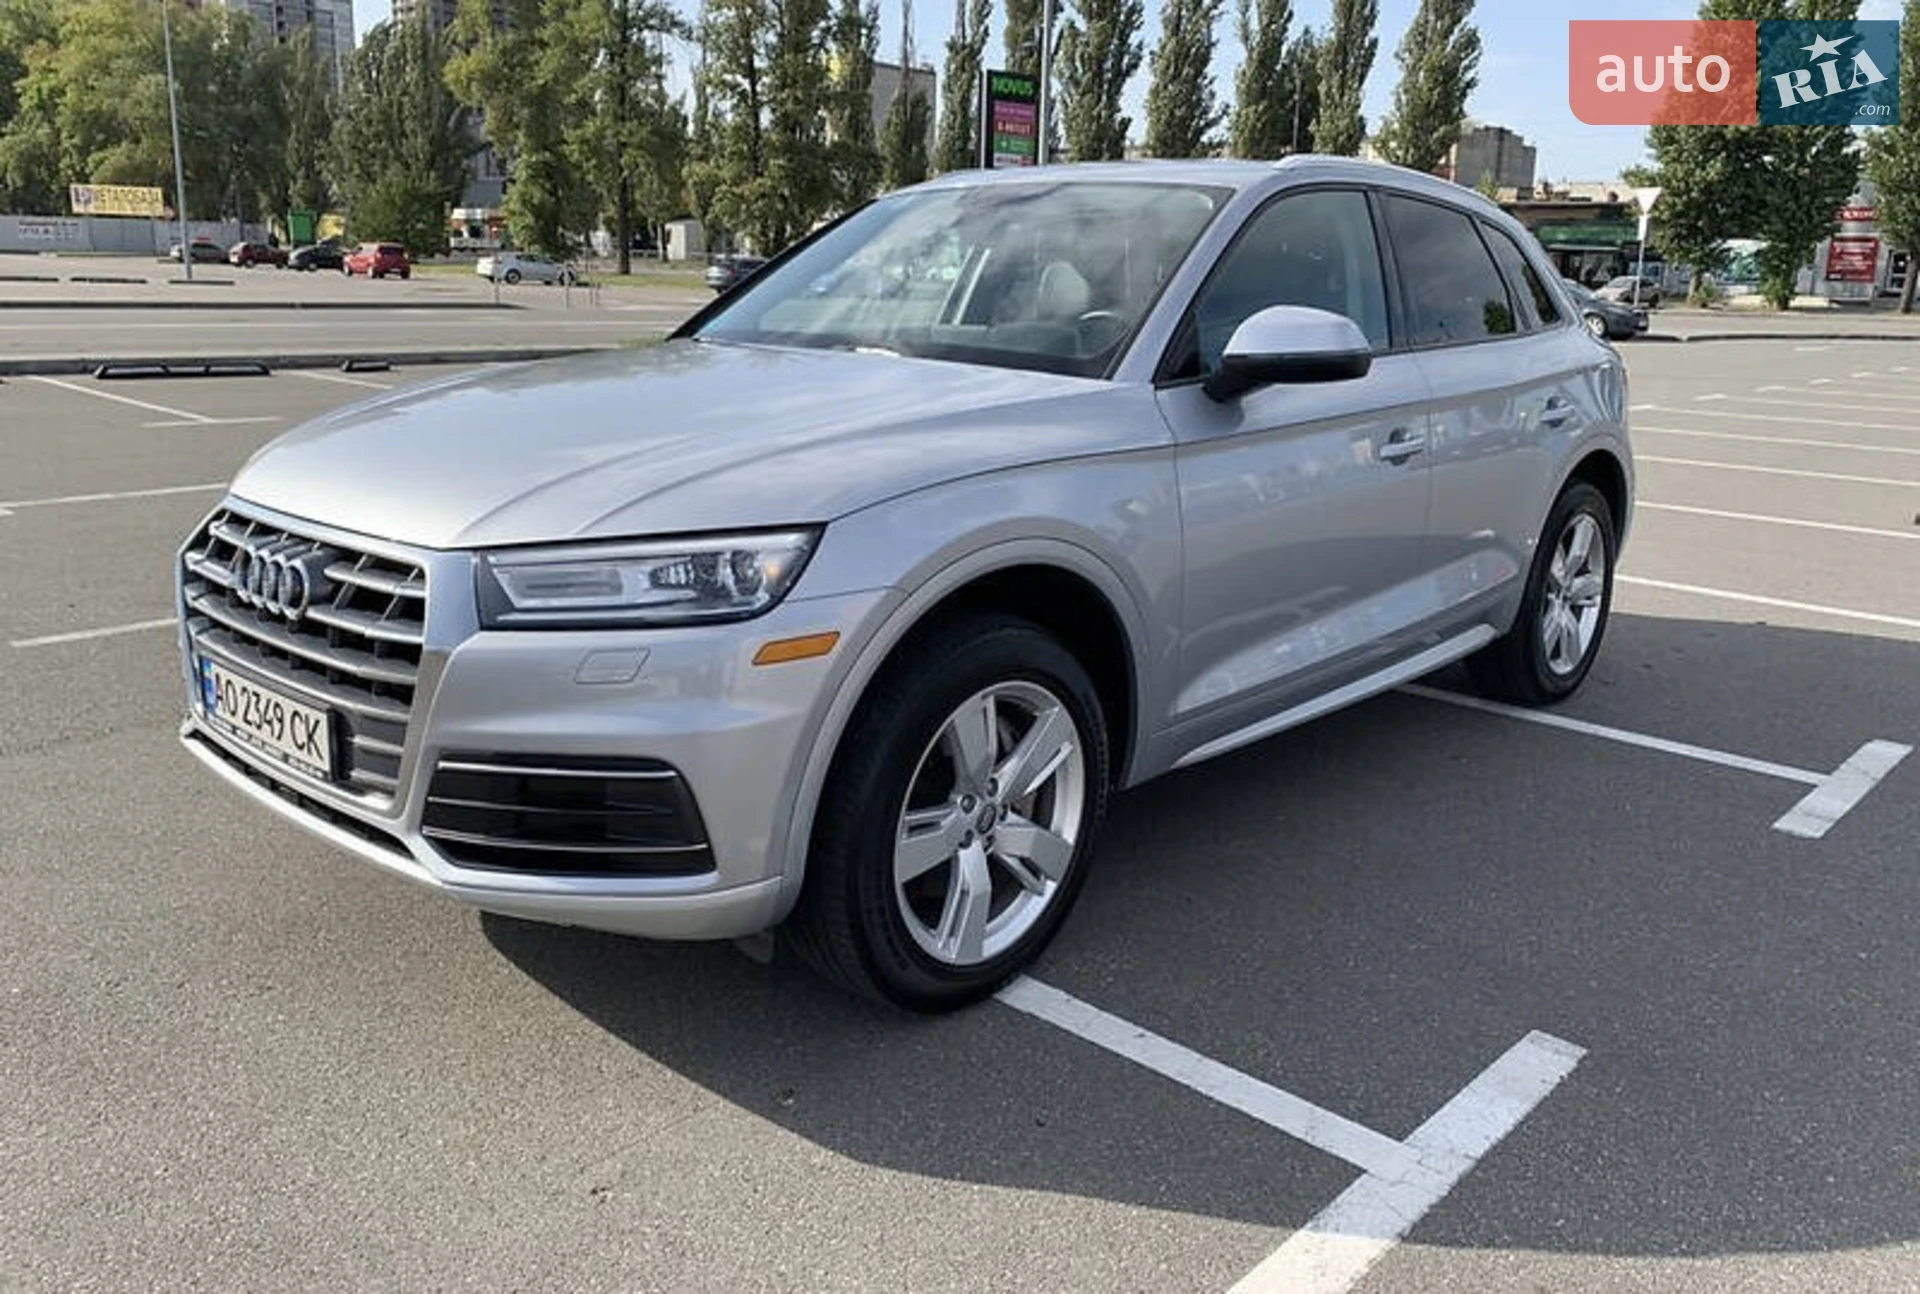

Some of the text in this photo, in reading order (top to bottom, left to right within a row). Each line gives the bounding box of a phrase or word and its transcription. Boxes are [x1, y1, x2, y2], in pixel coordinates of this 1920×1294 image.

[992, 77, 1034, 97] NOVUS
[240, 686, 285, 742] 2349
[290, 710, 325, 762] CK
